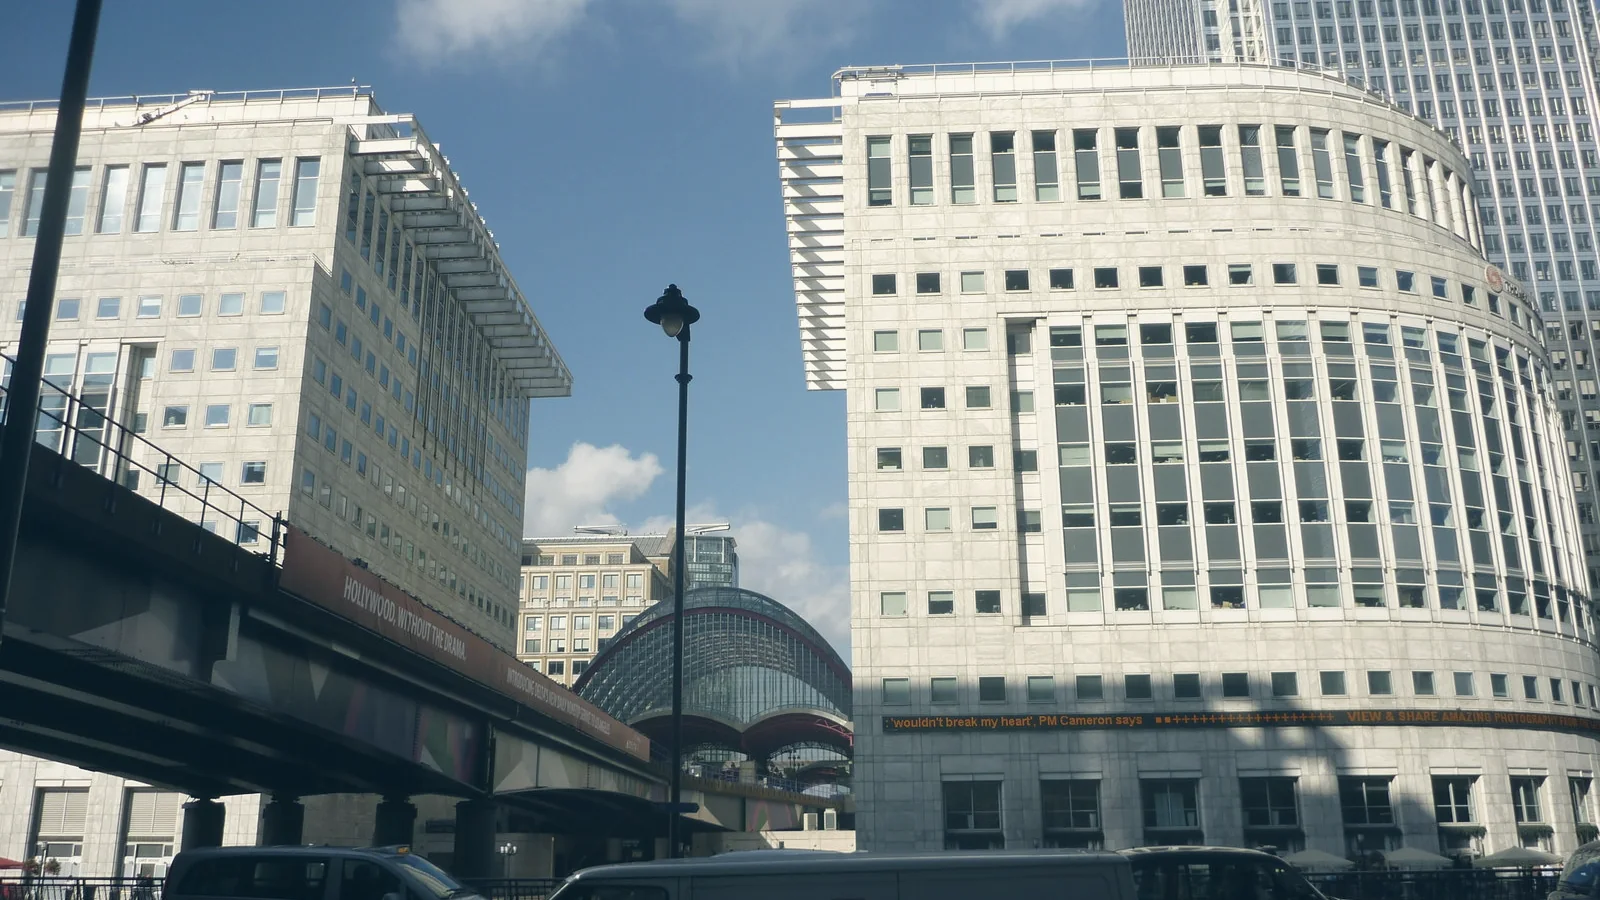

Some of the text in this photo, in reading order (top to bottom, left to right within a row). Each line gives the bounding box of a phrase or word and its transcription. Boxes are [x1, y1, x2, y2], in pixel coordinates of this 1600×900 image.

[343, 575, 467, 662] HOLLYWOOD, WITHOUT THE DRAMA.
[945, 716, 978, 728] break
[980, 718, 998, 729] my
[1039, 715, 1058, 726] PM
[1060, 715, 1112, 726] Cameron
[1115, 714, 1143, 727] says
[1347, 711, 1382, 721] VIEW
[1385, 711, 1395, 721] &
[1398, 711, 1439, 722] SHARE
[1442, 711, 1490, 723] AMAZING
[1494, 713, 1558, 726] PHOTOGRAPHY
